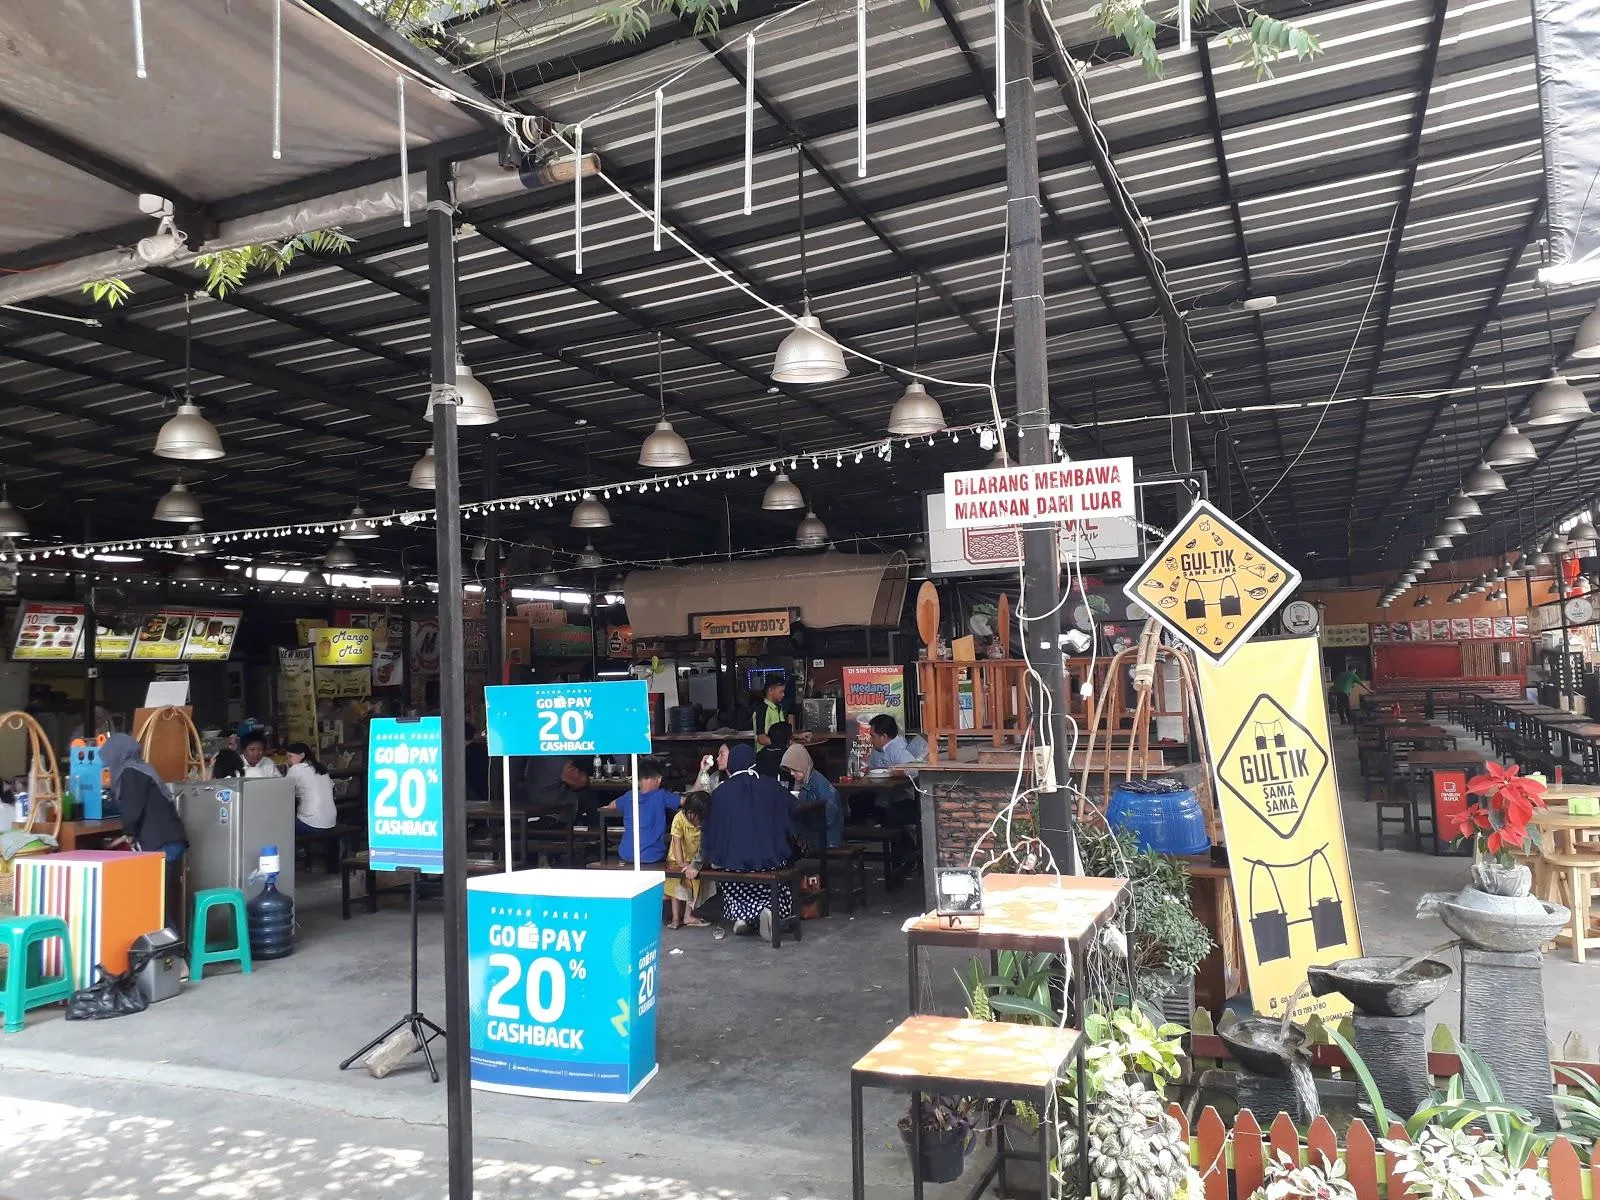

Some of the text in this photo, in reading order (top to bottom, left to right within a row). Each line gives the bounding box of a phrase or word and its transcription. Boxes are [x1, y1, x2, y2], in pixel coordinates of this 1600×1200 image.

[954, 465, 1121, 496] DILARANG MEMBAWA
[955, 490, 1122, 520] MAKANAN DARI LUAR
[1181, 549, 1236, 571] GULTIK
[1212, 566, 1237, 575] SAMA
[26, 614, 39, 624] 10
[731, 618, 786, 633] COWBOY
[332, 630, 369, 646] Mango
[338, 645, 363, 658] Mas
[850, 682, 890, 695] Wedang
[884, 693, 901, 707] 75
[537, 709, 594, 741] 20%
[540, 740, 595, 751] CASHBACK
[1240, 749, 1309, 784] GULTIK
[374, 767, 438, 819] 20%
[1263, 784, 1295, 799] SAMA
[1266, 798, 1298, 812] SAMA
[374, 819, 438, 837] CASHBACK
[490, 906, 589, 920] BAYAR PAKAI
[487, 952, 587, 1024] 20%
[487, 1020, 585, 1050] CASHBACK
